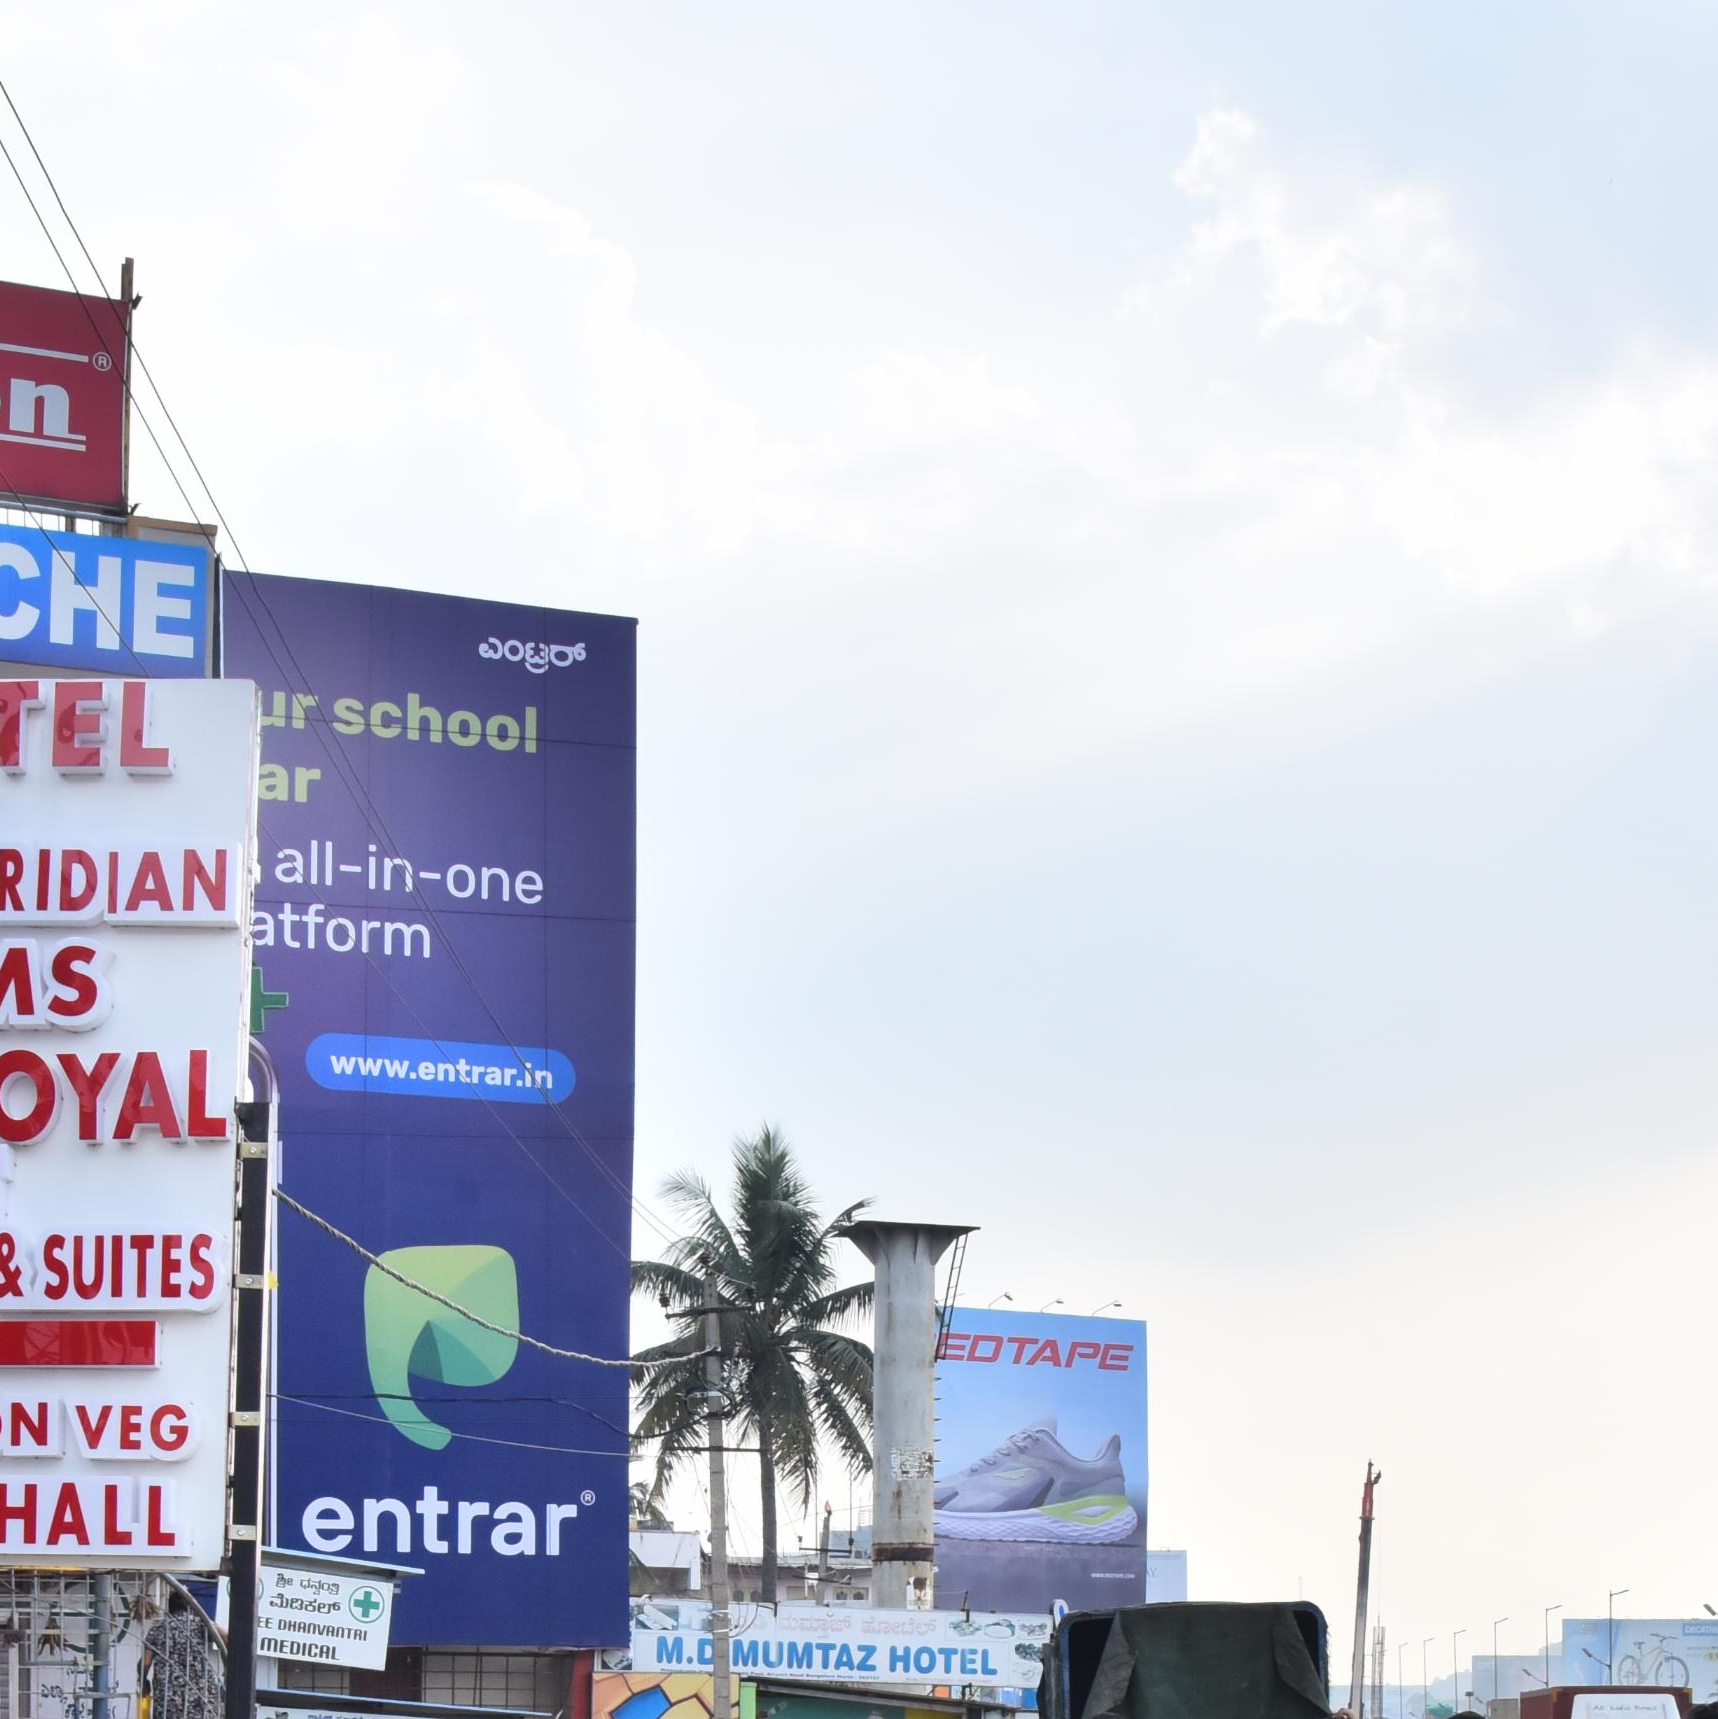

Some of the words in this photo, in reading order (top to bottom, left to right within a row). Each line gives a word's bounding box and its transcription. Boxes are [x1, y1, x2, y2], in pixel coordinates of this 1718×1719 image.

[332, 692, 538, 753] school
[274, 839, 544, 904] all-in-one
[330, 1050, 553, 1090] www.entrar.in
[43, 1233, 215, 1299] SUITES
[936, 1332, 1134, 1371] EDTAPE
[75, 1403, 189, 1451] VEG
[301, 1486, 578, 1556] entrar
[259, 1636, 341, 1661] MEDICAL
[277, 1618, 368, 1641] DHANVANTRI
[731, 1638, 877, 1672] MUMTAZ
[888, 1645, 998, 1676] HOTEL
